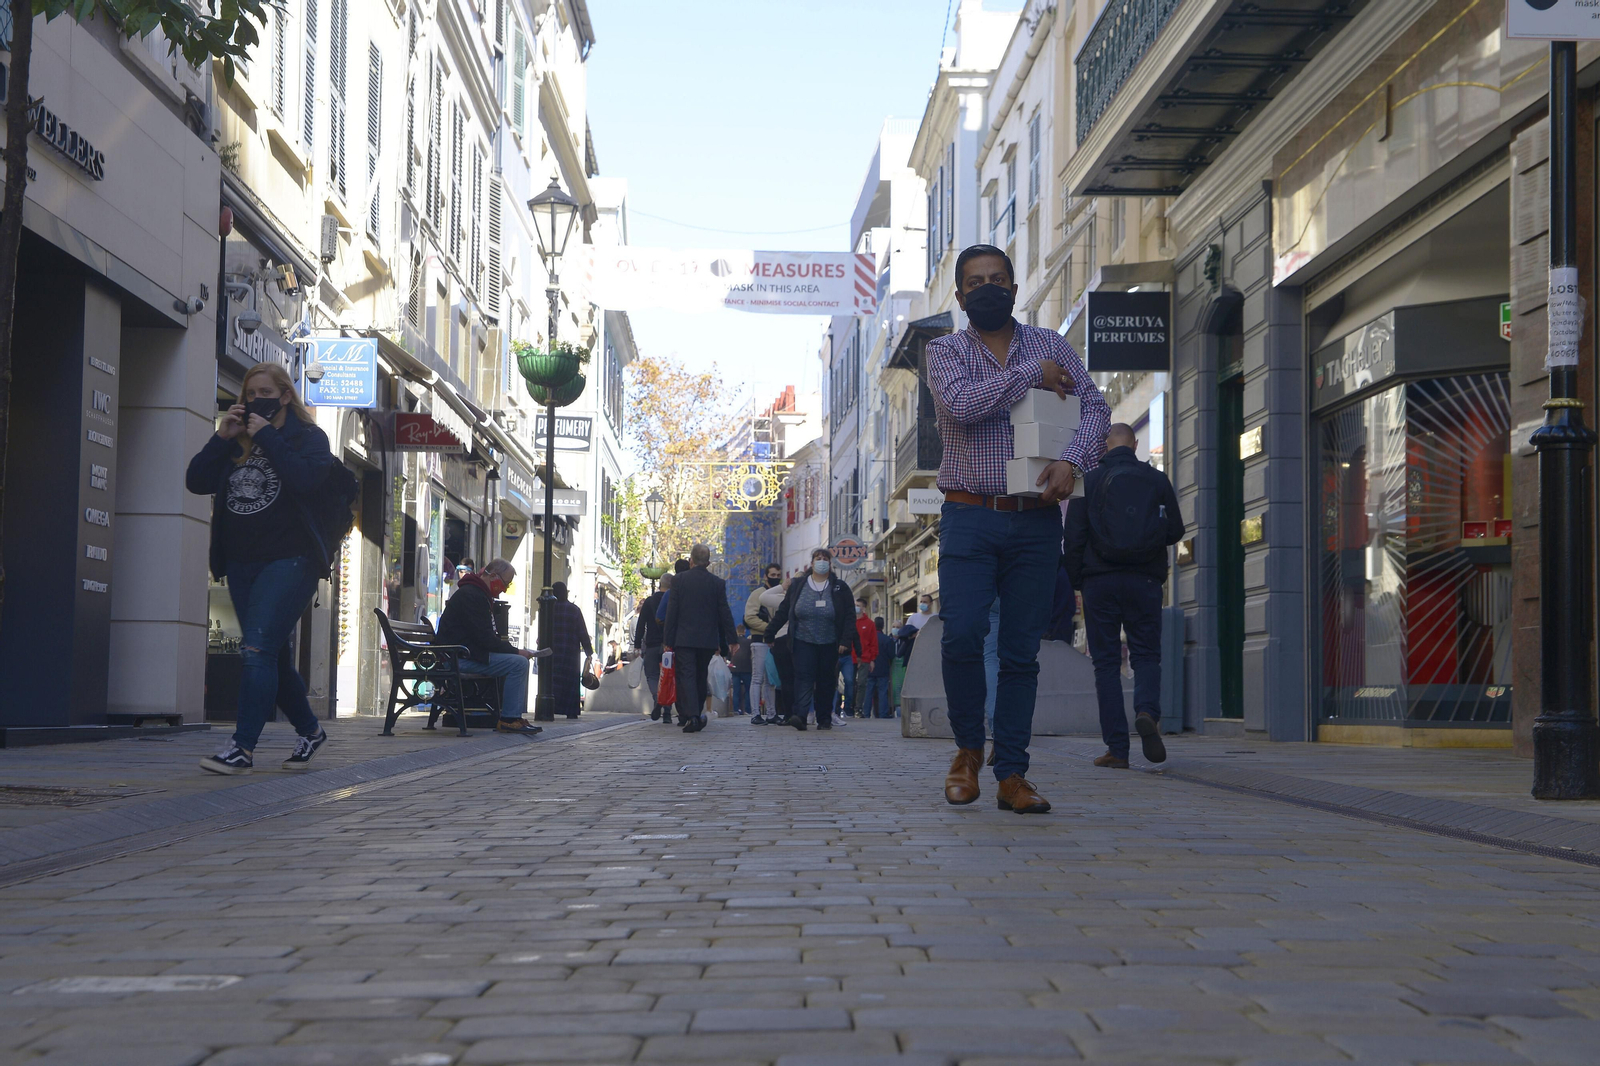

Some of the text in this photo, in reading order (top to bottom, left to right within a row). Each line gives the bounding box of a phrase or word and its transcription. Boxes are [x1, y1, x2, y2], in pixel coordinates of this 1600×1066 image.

[27, 94, 105, 181] WELLERS
[744, 262, 846, 279] MEASURES
[756, 283, 767, 292] IN
[769, 284, 792, 293] THIS
[793, 284, 821, 293] AREA
[1093, 315, 1165, 329] @SERUYA
[1093, 332, 1165, 343] PERFUMES
[89, 356, 116, 375] BREITLING
[341, 379, 363, 387] 52488
[92, 389, 111, 414] IWC
[536, 417, 591, 437] PEFUMERY
[507, 467, 532, 499] PEACOCKS
[233, 498, 268, 512] ROGER
[85, 507, 110, 527] OMEGA
[829, 546, 867, 557] VIJAY
